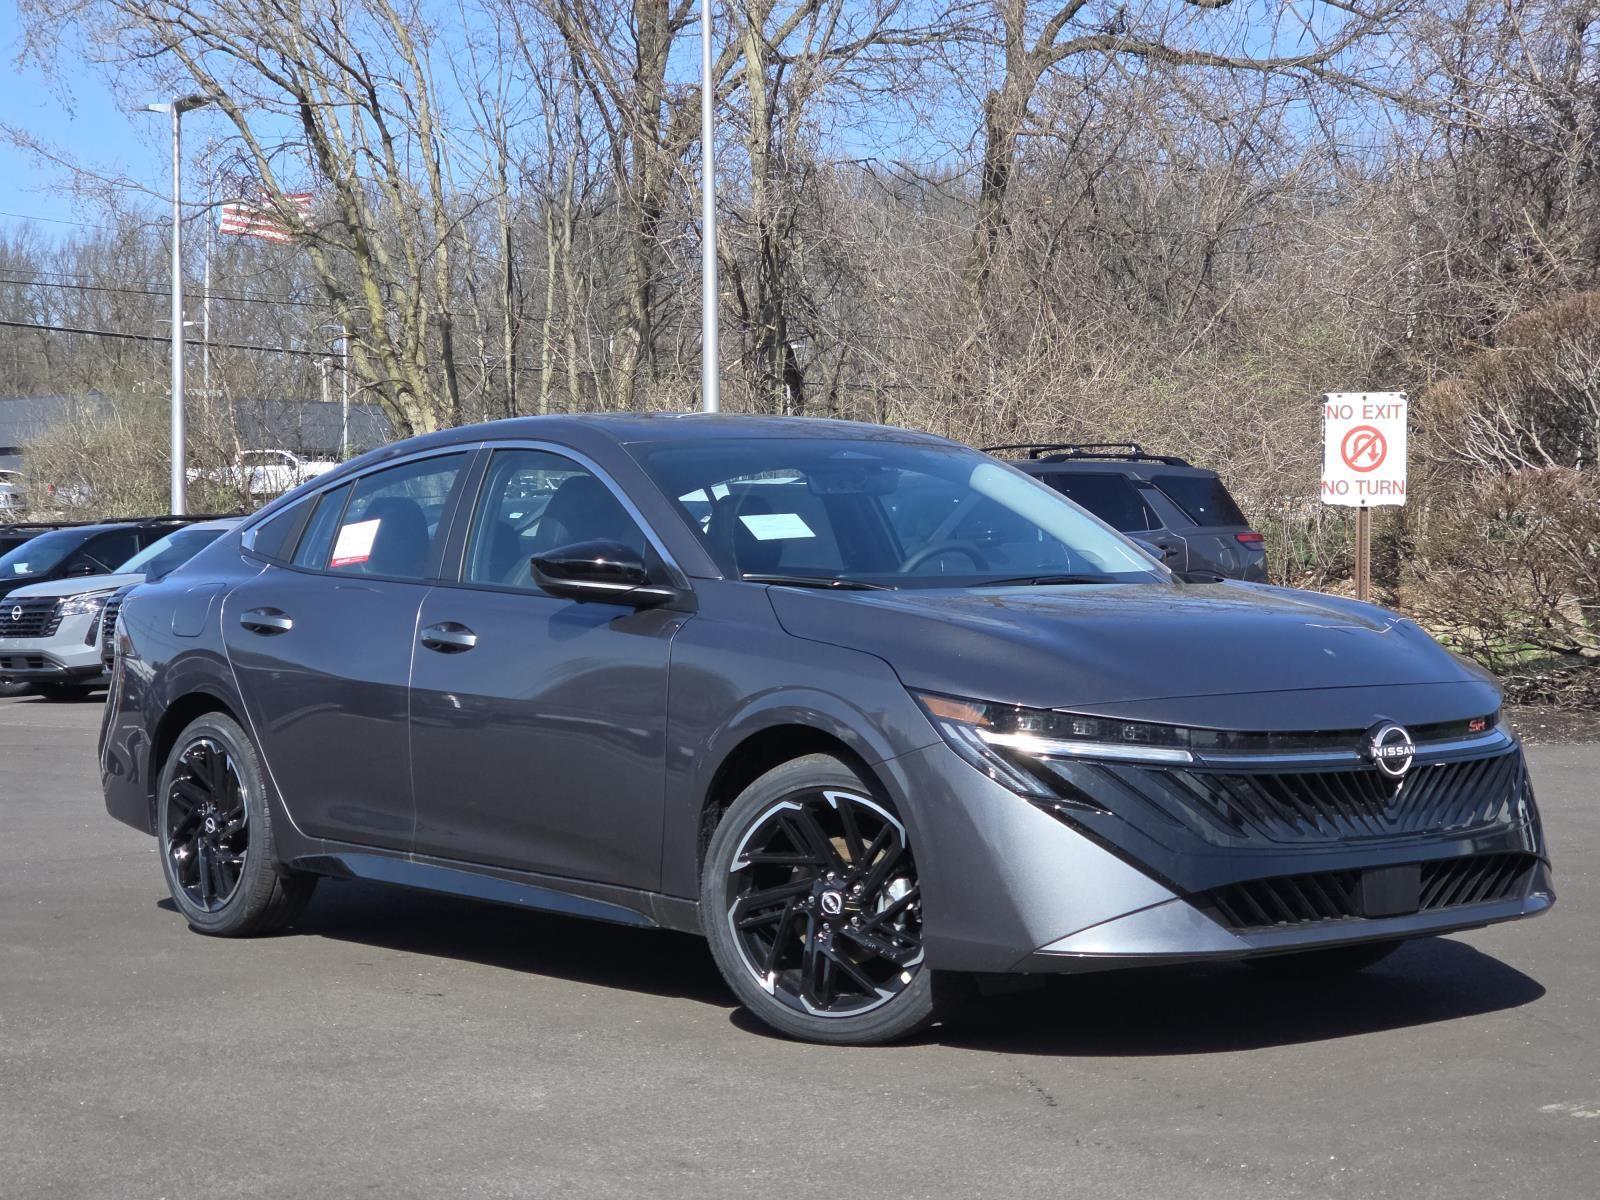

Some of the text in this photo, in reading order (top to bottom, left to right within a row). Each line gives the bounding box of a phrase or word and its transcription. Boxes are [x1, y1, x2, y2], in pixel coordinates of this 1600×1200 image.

[1326, 404, 1403, 420] NO EXIT
[1321, 479, 1405, 496] NO TURN
[1372, 745, 1416, 757] NISSAN
